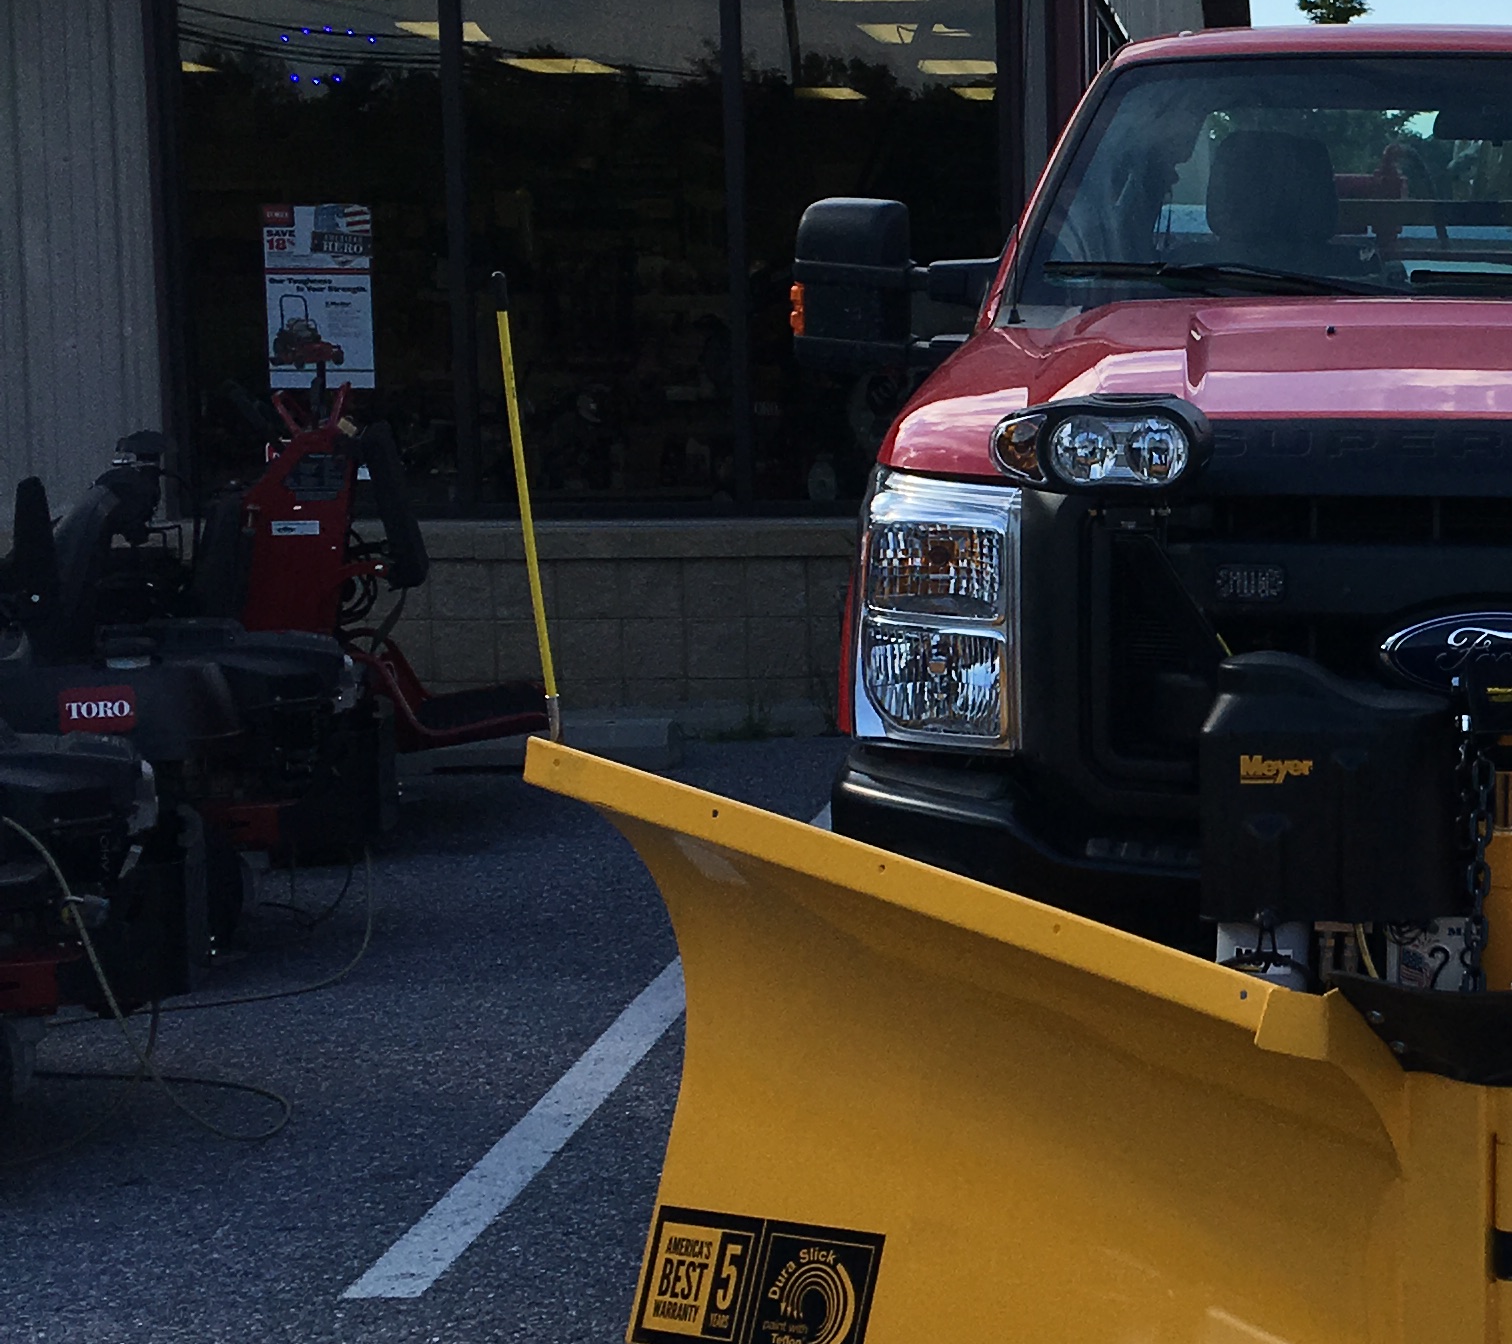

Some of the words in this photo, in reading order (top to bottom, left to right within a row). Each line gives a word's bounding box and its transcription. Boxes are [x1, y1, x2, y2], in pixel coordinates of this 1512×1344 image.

[266, 230, 296, 238] SAVE
[322, 241, 363, 254] HERO
[65, 700, 131, 720] TORO
[1239, 754, 1314, 785] Meyer
[664, 1236, 714, 1260] AMERICA'S
[656, 1258, 710, 1303] BEST
[715, 1243, 742, 1311] 5
[767, 1260, 796, 1301] Dura
[798, 1246, 838, 1267] Slick
[651, 1298, 701, 1324] WARRANTY
[709, 1312, 731, 1330] YEARS
[761, 1319, 788, 1333] paint
[788, 1323, 809, 1336] with
